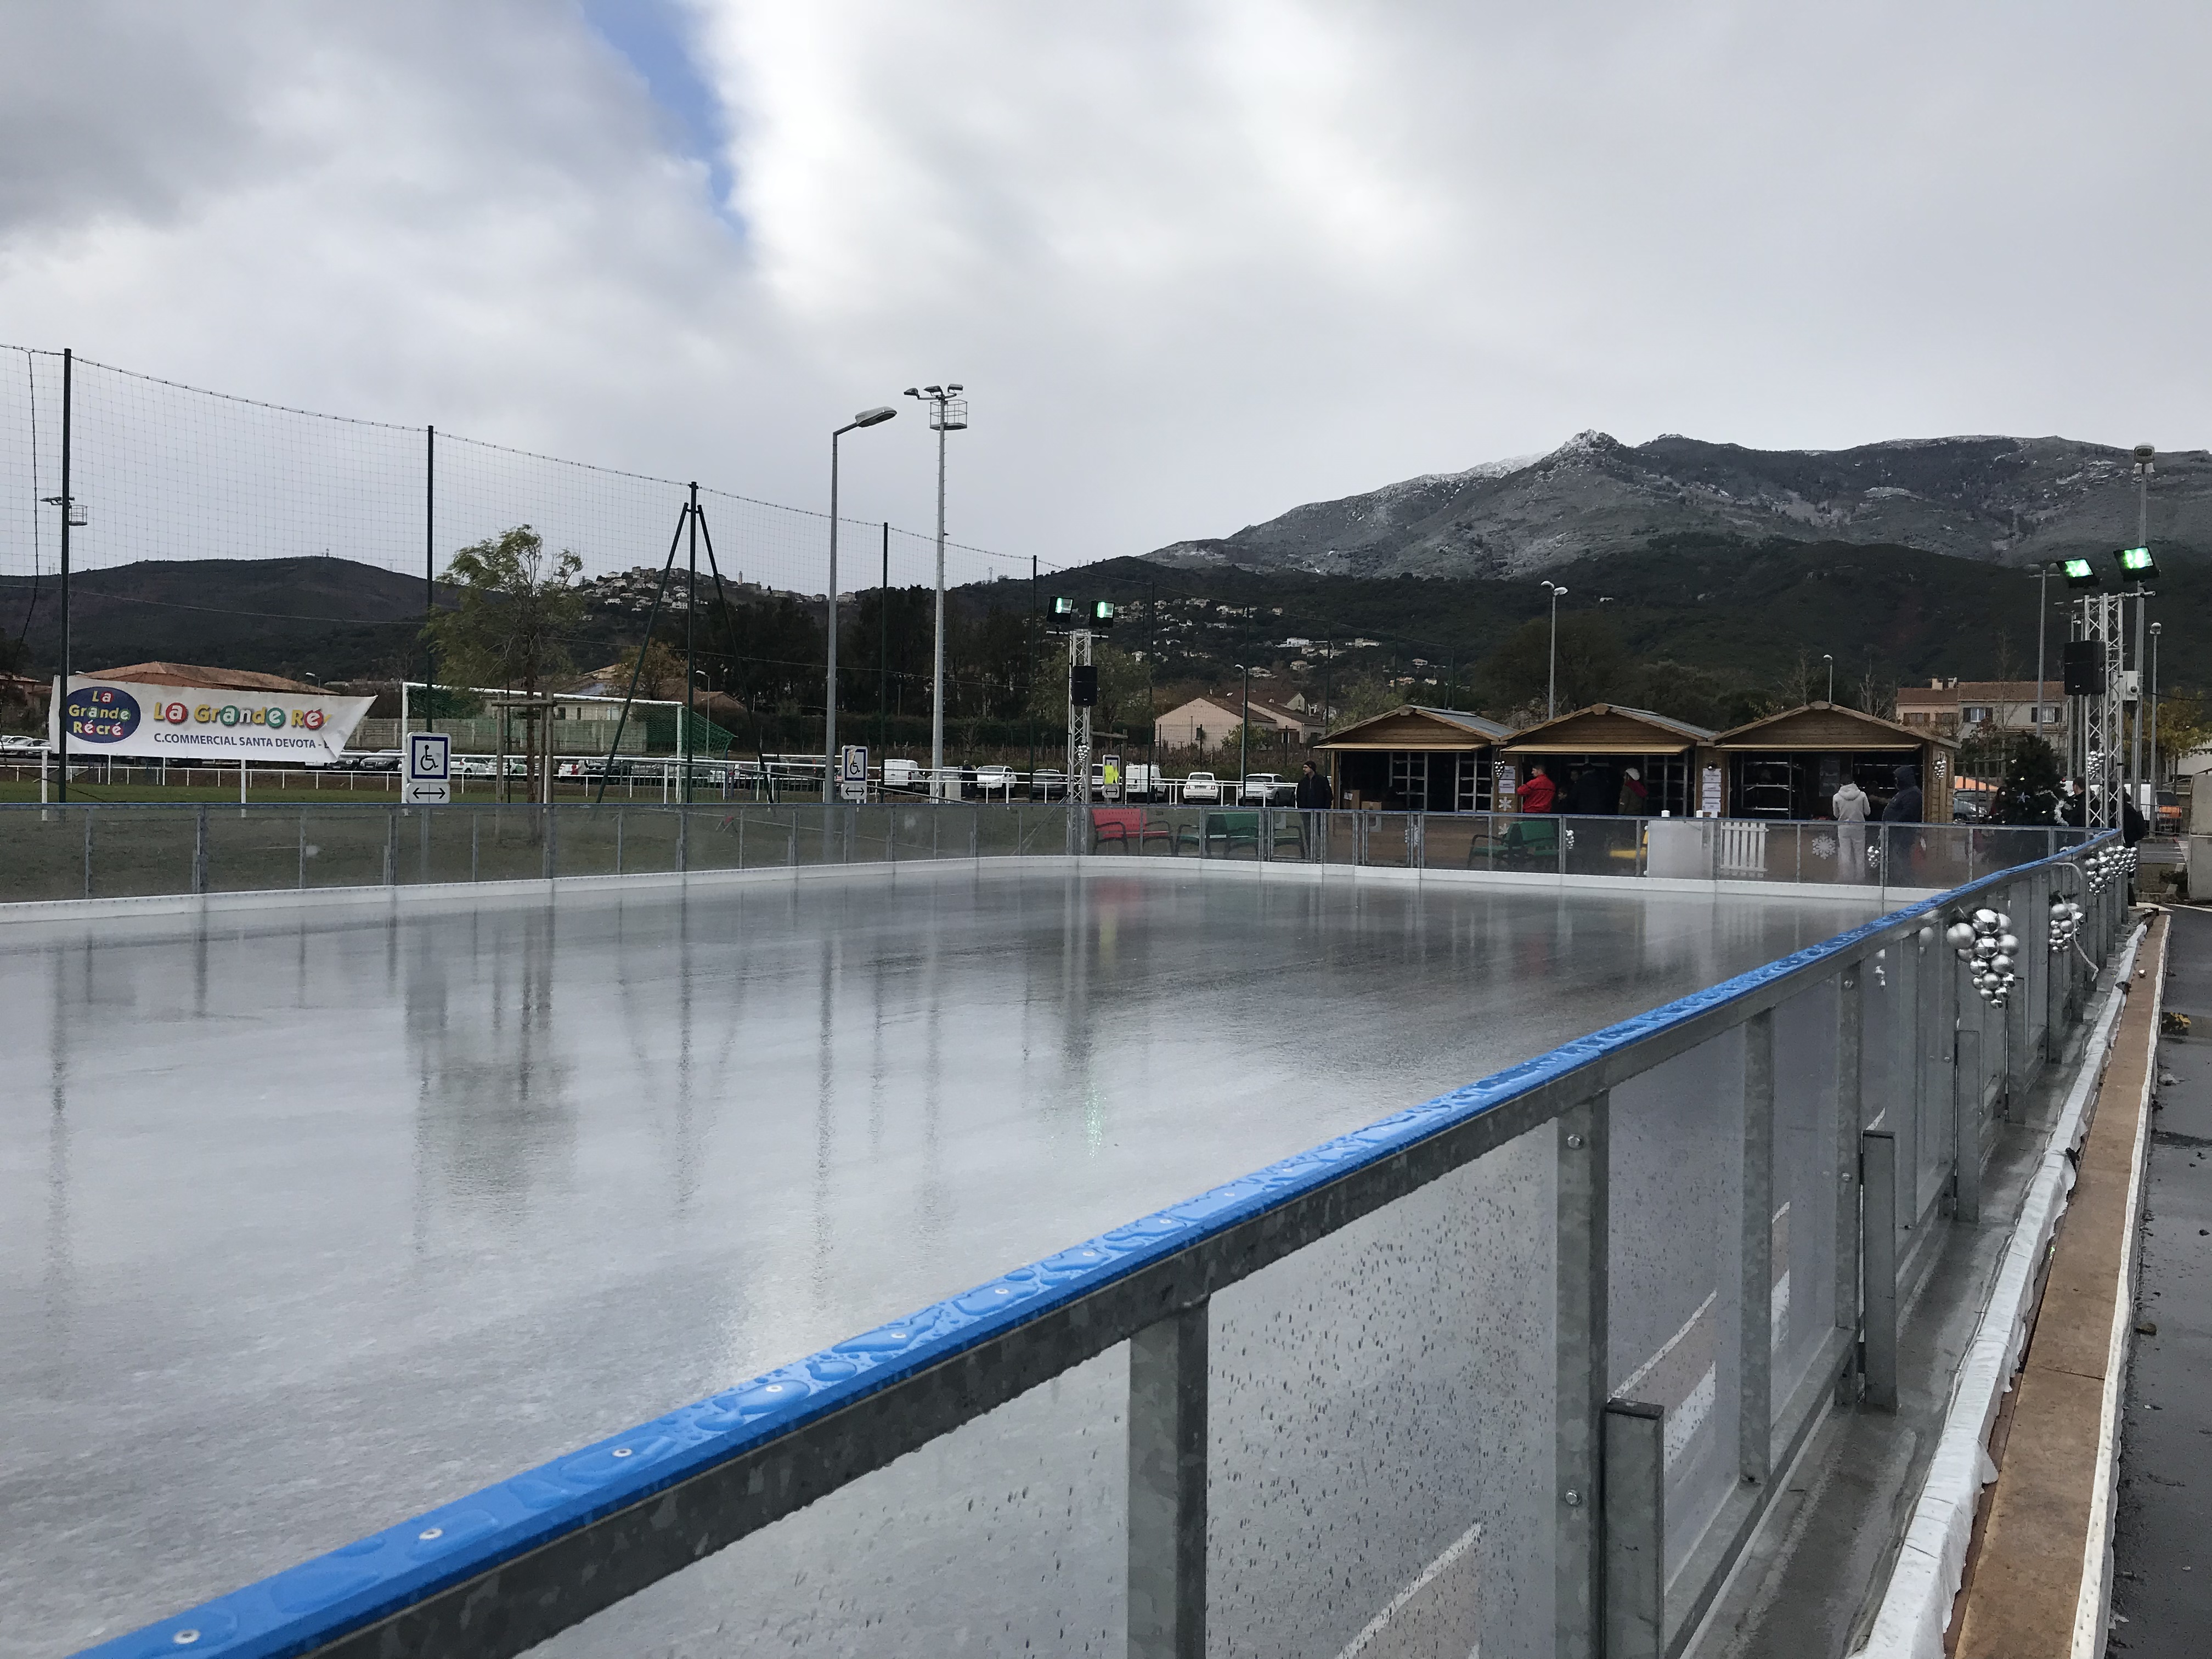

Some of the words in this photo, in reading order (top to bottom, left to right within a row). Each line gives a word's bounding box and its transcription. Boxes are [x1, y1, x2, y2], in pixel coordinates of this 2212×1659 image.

[92, 690, 112, 703] La
[69, 704, 130, 721] Grande
[153, 702, 187, 723] La
[194, 704, 285, 727] Grande
[73, 719, 122, 736] Récré
[154, 733, 237, 746] C.COMMERCIAL
[240, 736, 273, 747] SANTA
[275, 738, 317, 748] DEVOTA
